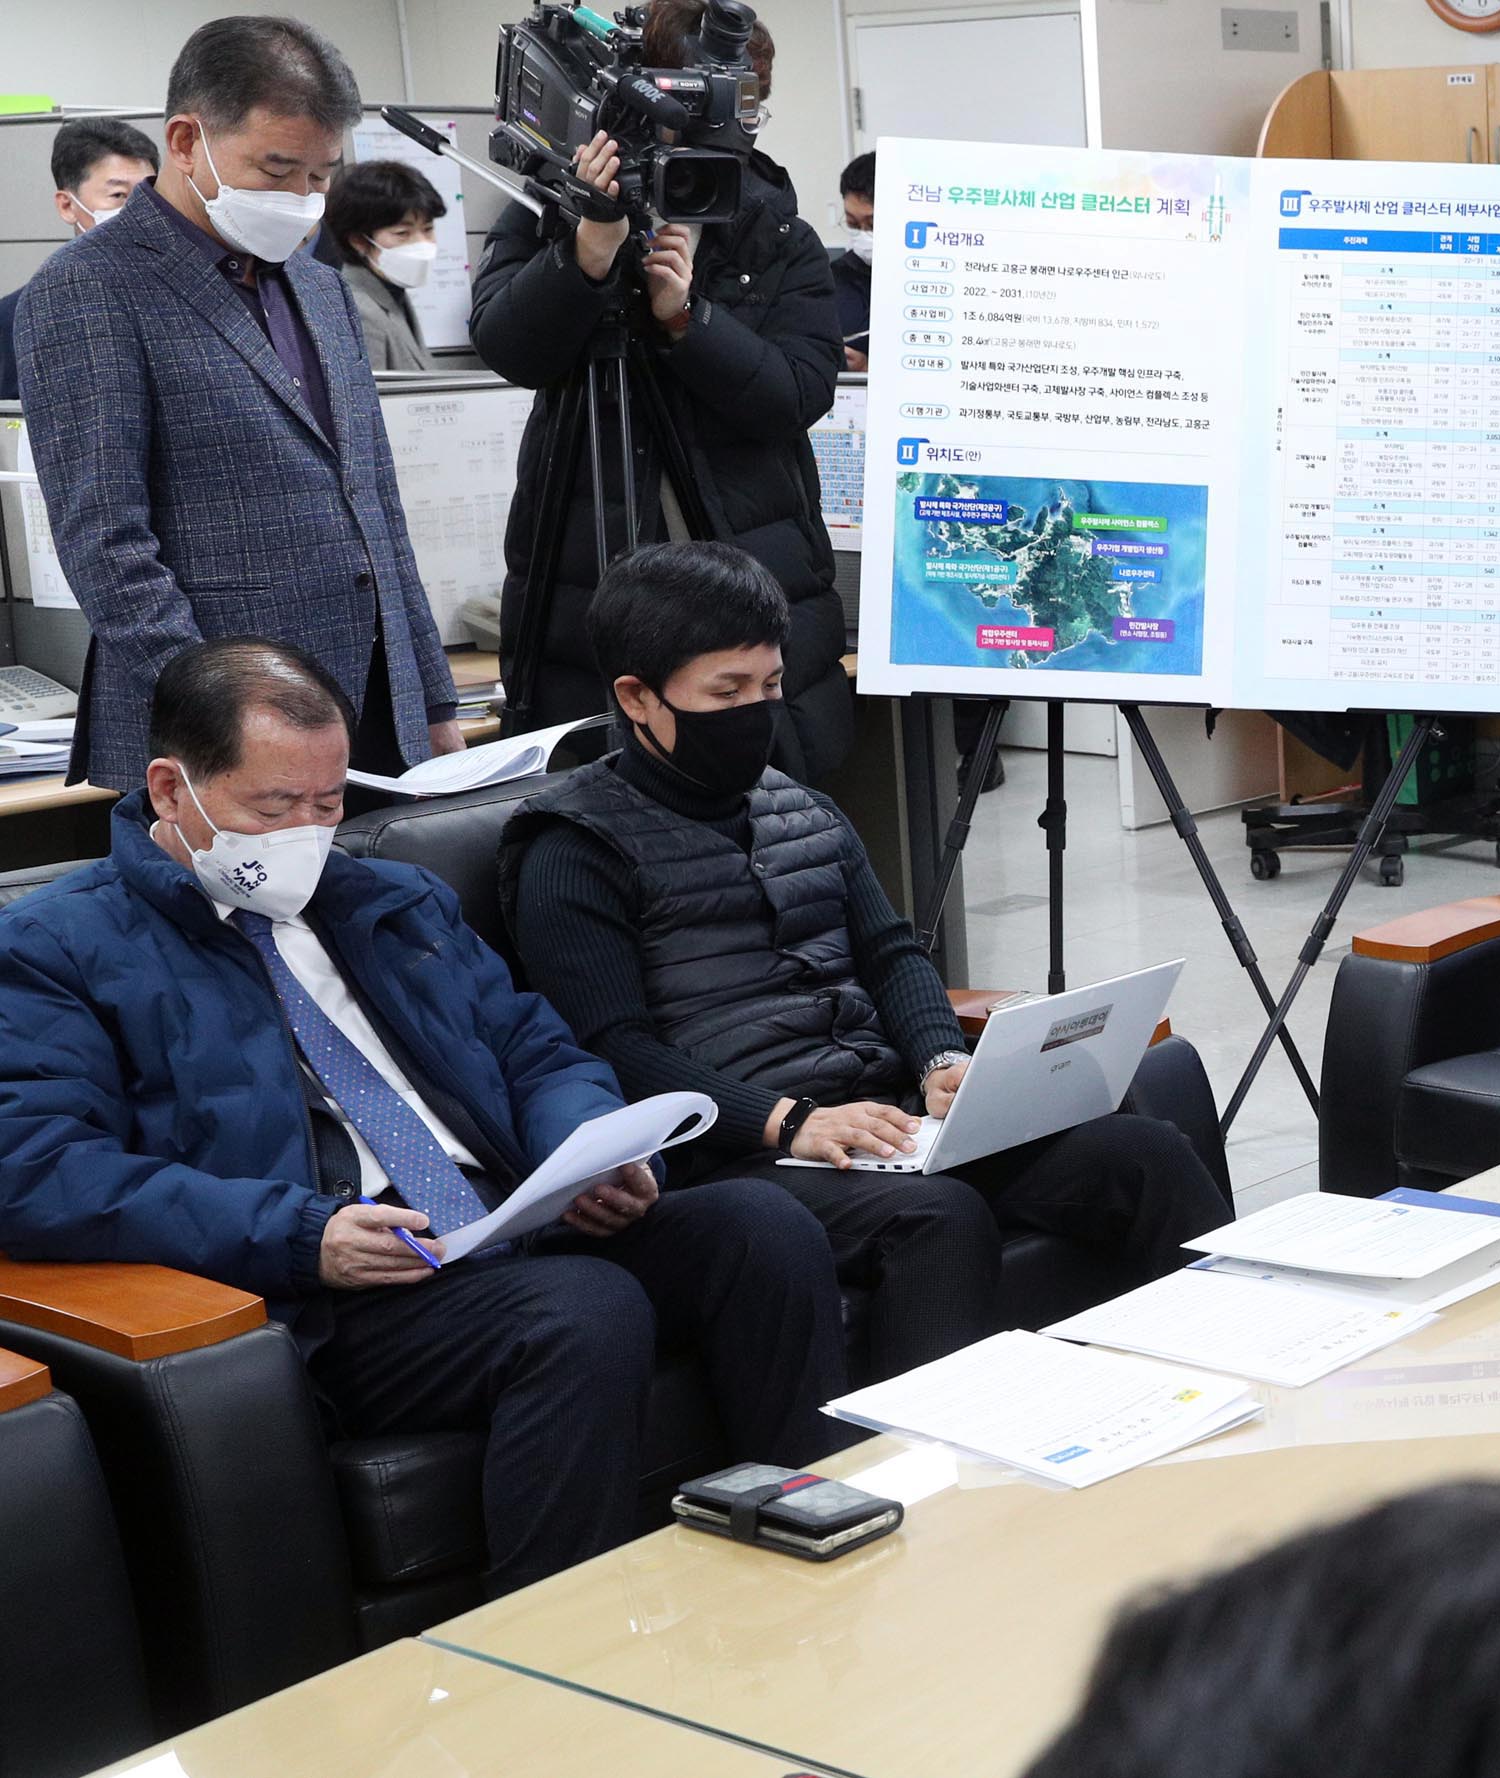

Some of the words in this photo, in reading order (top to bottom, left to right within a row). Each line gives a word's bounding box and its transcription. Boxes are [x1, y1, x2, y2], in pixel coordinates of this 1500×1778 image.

[908, 184, 942, 202] 전남
[947, 186, 1035, 208] 우주발사체
[1041, 191, 1075, 210] 산업
[1082, 193, 1151, 214] 클러스터
[1157, 197, 1190, 216] 계획
[1309, 199, 1371, 214] 우주발사체
[1374, 201, 1398, 215] 산업
[1402, 201, 1451, 217] 클러스터
[934, 231, 985, 246] 사업개요
[965, 261, 999, 272] 전라남도
[1002, 264, 1027, 275] 고흥군
[1030, 265, 1055, 276] 봉래면
[1057, 266, 1110, 279] 나로우주센터
[911, 284, 947, 294] 사업기간
[910, 309, 946, 319] 총사업비
[963, 311, 977, 321] 1조
[908, 359, 944, 369] 사업내용
[961, 360, 986, 371] 발사체
[988, 361, 1005, 371] 특화
[1007, 362, 1058, 375] 국가산업단지
[1060, 365, 1080, 376] 조성,
[1083, 366, 1116, 377] 우주개발
[1118, 368, 1135, 379] 핵심
[1137, 368, 1163, 379] 인프라
[1164, 370, 1184, 381] 구축,
[960, 381, 1020, 393] 기술사업화센터
[1022, 383, 1041, 394] 구축,
[1043, 385, 1086, 396] 고체발사장
[1088, 387, 1108, 398] 구축,
[1109, 388, 1144, 399] 사이언스
[1146, 389, 1180, 401] 컴플렉스
[1182, 391, 1198, 402] 조성
[1200, 392, 1209, 403] 등
[906, 406, 943, 417] 시행기관
[959, 408, 1004, 420] 과기정통부,
[1007, 410, 1052, 423] 국토교통부,
[1055, 412, 1082, 424] 국방부,
[1084, 414, 1113, 426] 산업부,
[1115, 415, 1144, 427] 농림부,
[1146, 416, 1182, 429] 전라남도,
[1184, 418, 1210, 430] 고흥군
[926, 447, 982, 462] 위치도(안)
